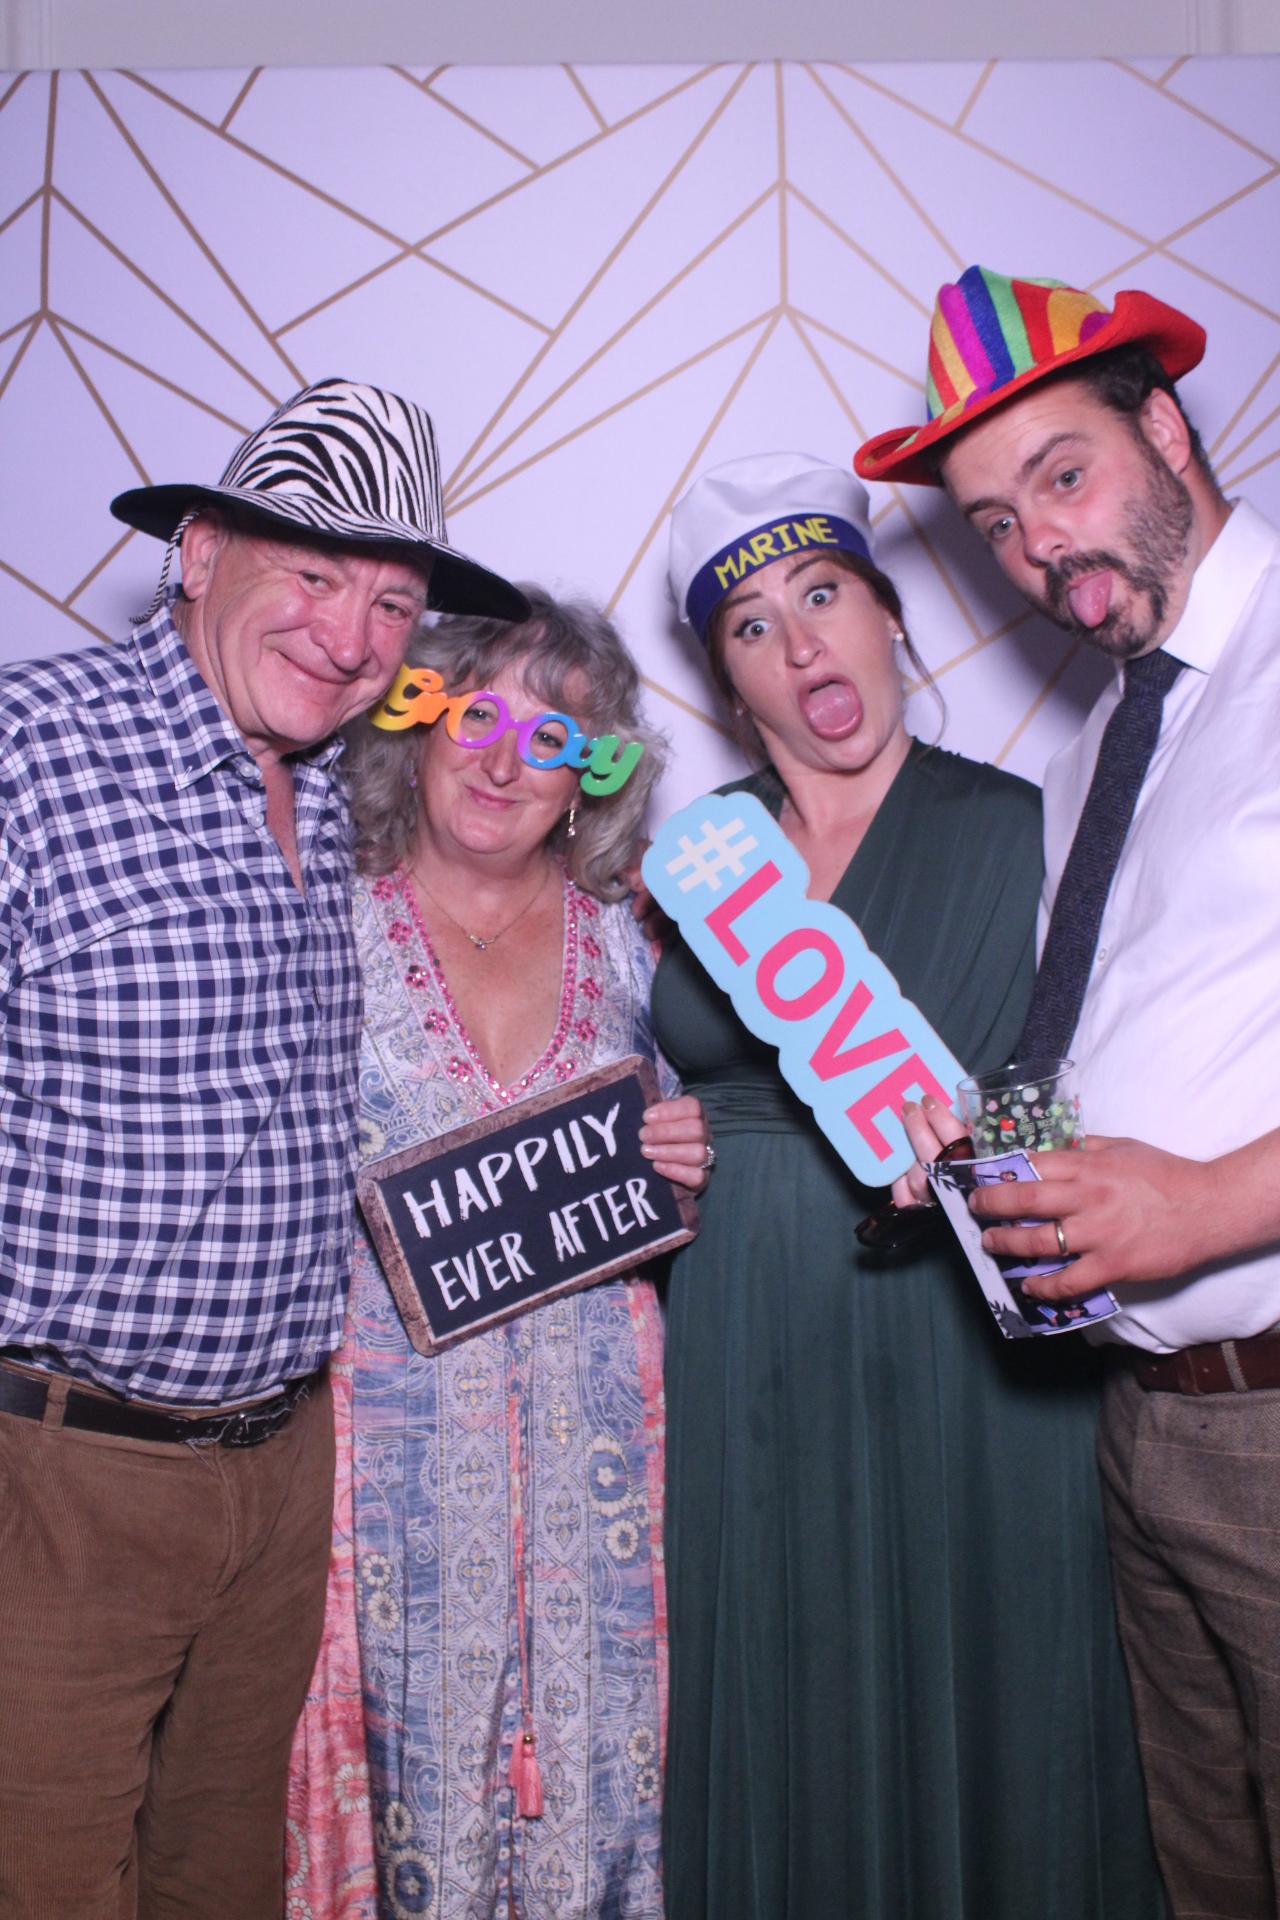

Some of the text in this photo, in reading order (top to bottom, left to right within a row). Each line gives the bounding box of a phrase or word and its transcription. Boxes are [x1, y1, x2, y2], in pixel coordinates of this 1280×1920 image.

[714, 517, 839, 590] MARINE
[665, 817, 954, 1163] #LOVE
[402, 1102, 621, 1238] HAPPILY
[430, 1177, 661, 1311] EVER AFTER
